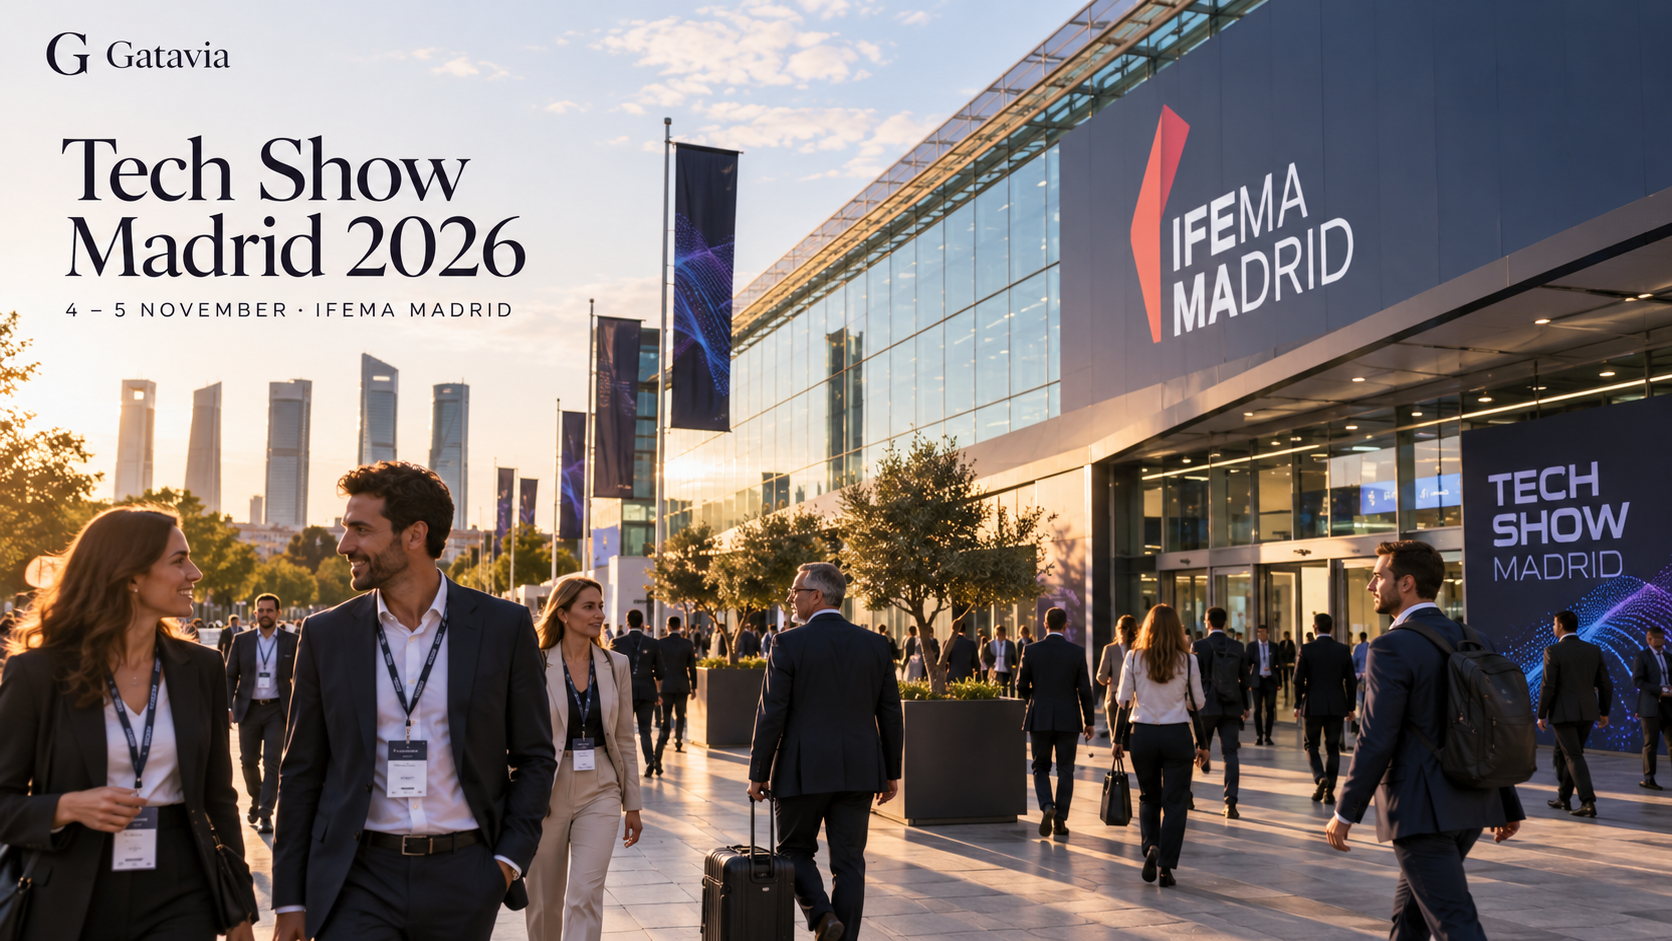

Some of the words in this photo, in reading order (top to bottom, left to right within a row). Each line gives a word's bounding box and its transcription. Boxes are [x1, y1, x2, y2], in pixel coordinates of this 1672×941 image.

[1172, 162, 1308, 272] IFEMA
[1173, 218, 1354, 337] MADRID
[1488, 461, 1599, 507] TECH
[1493, 501, 1630, 548] SHOW
[1493, 550, 1623, 582] MADRID
